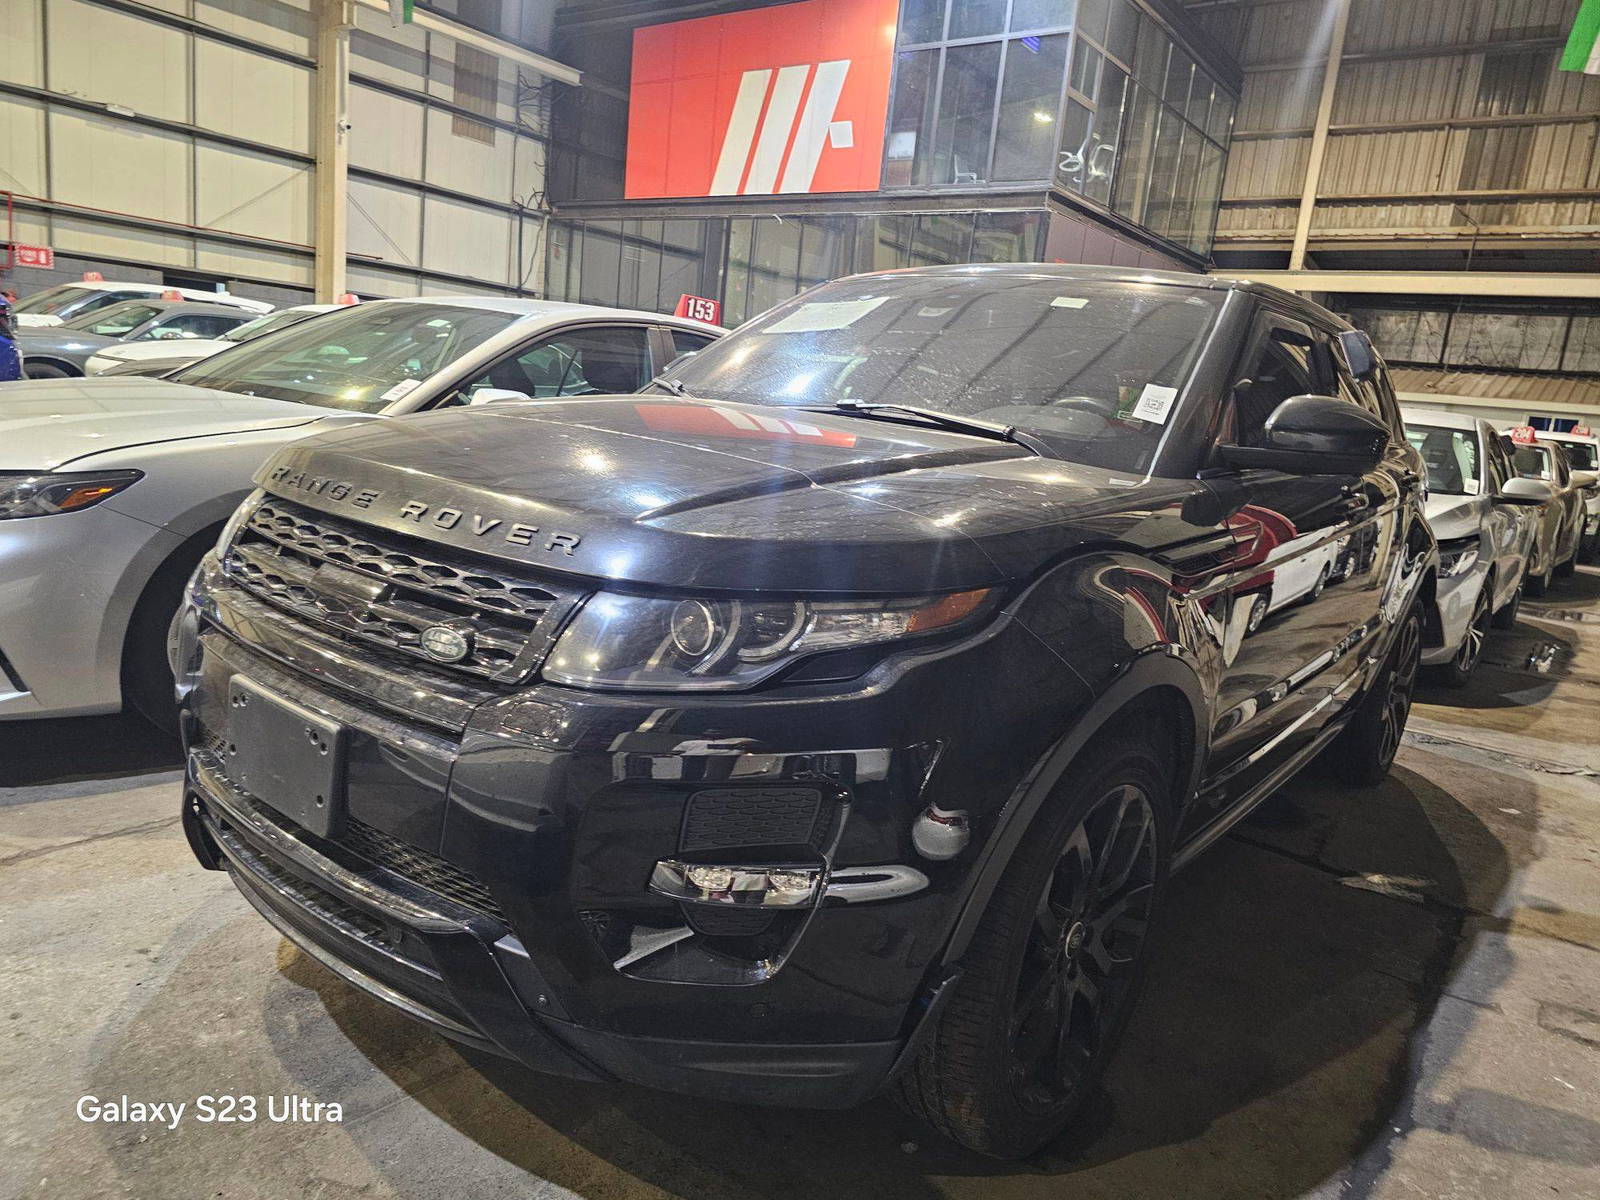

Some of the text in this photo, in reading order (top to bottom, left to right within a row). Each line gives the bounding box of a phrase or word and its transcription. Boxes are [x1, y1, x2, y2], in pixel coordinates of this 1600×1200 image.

[687, 298, 715, 321] 153
[271, 466, 581, 557] RANGE ROVER
